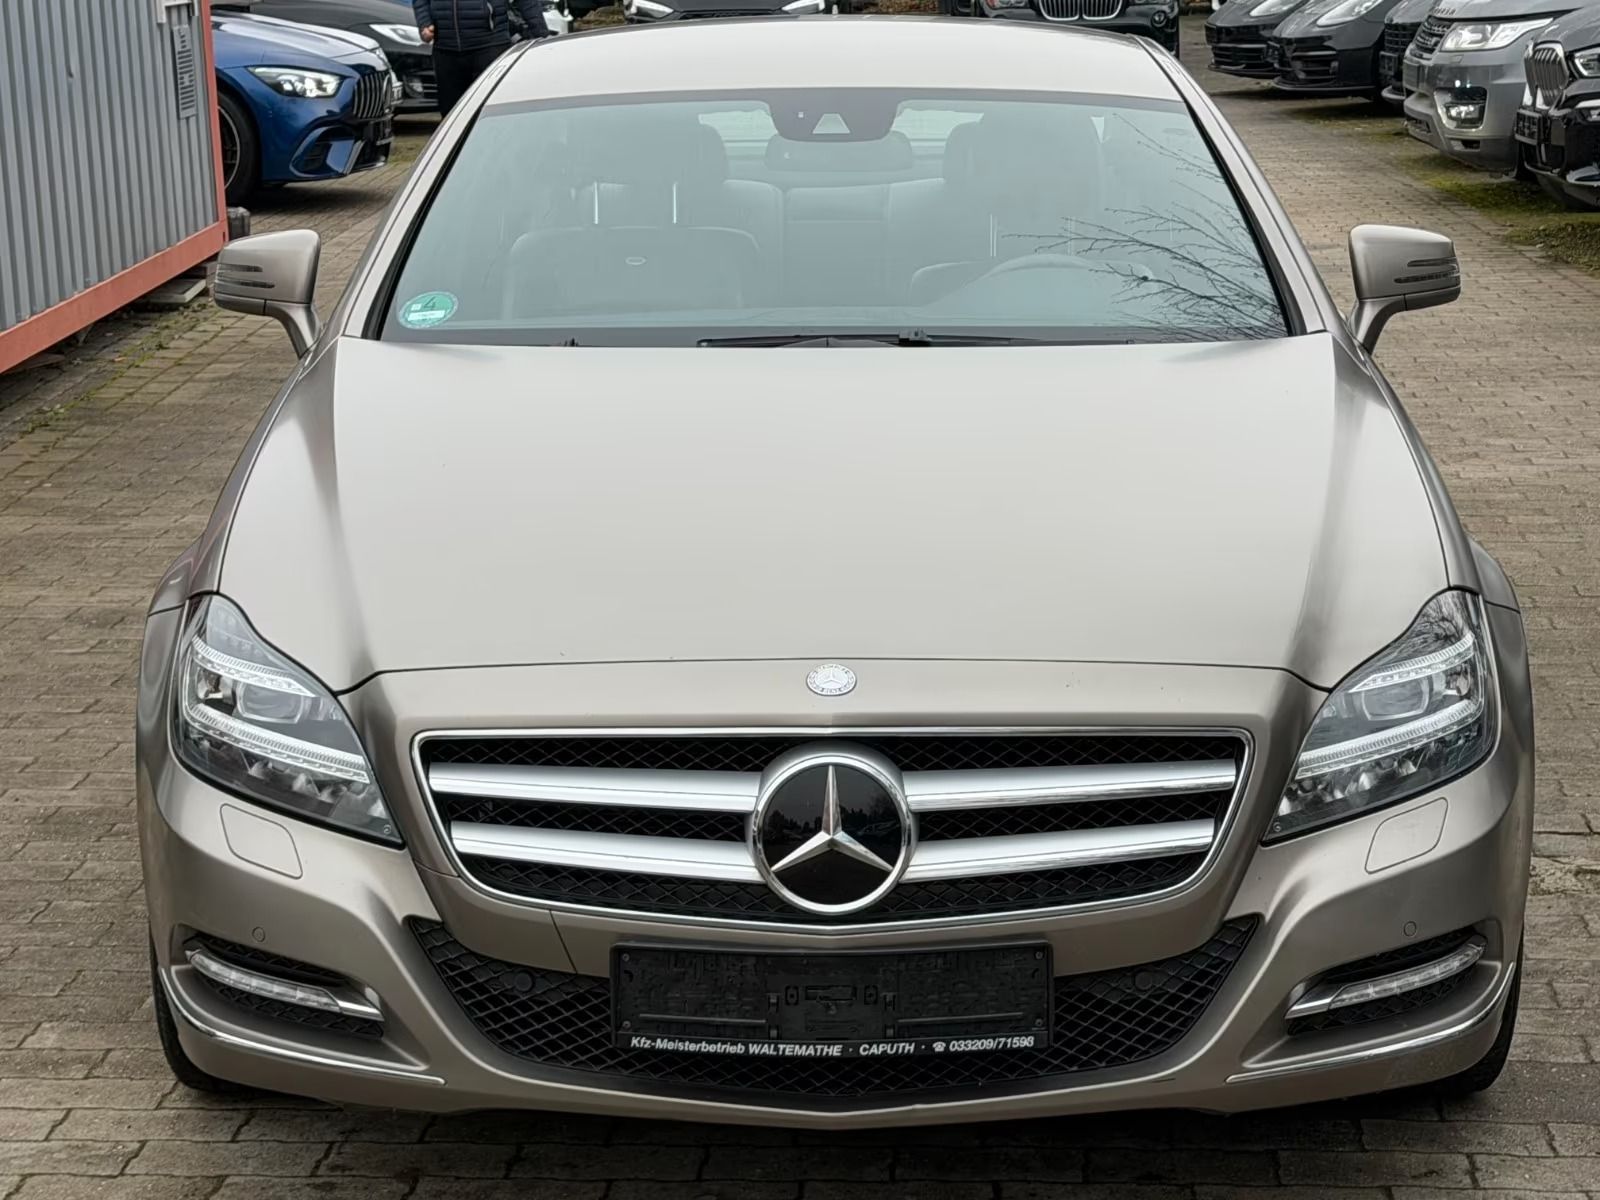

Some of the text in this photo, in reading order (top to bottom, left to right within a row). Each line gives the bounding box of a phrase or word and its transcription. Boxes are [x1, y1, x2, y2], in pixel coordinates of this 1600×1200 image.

[423, 296, 436, 310] 4
[631, 1036, 745, 1054] Kfz-Meisterbetrieb
[748, 1043, 842, 1057] WALTEMATHE
[859, 1042, 915, 1056] CAPUTH
